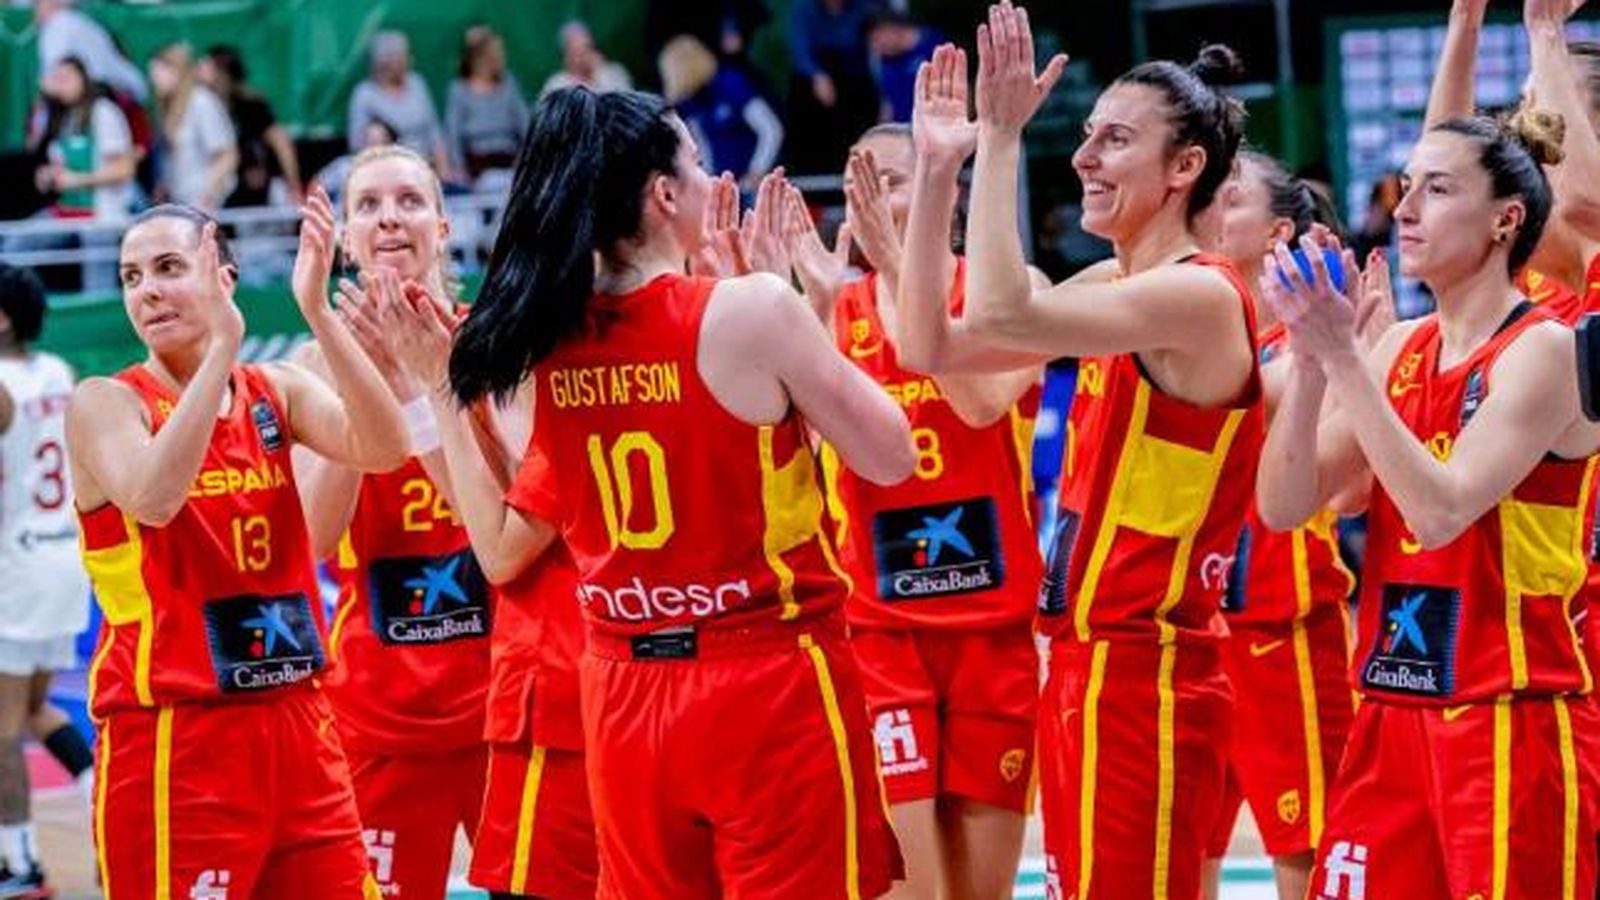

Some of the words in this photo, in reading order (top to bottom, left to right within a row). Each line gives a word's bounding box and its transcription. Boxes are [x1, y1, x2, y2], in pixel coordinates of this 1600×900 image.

[550, 361, 681, 408] GUSTAFSON
[912, 427, 944, 480] 8
[587, 431, 675, 551] 10
[232, 515, 271, 572] 13
[893, 566, 993, 596] CaixaBank
[387, 614, 484, 642] CaixaBank
